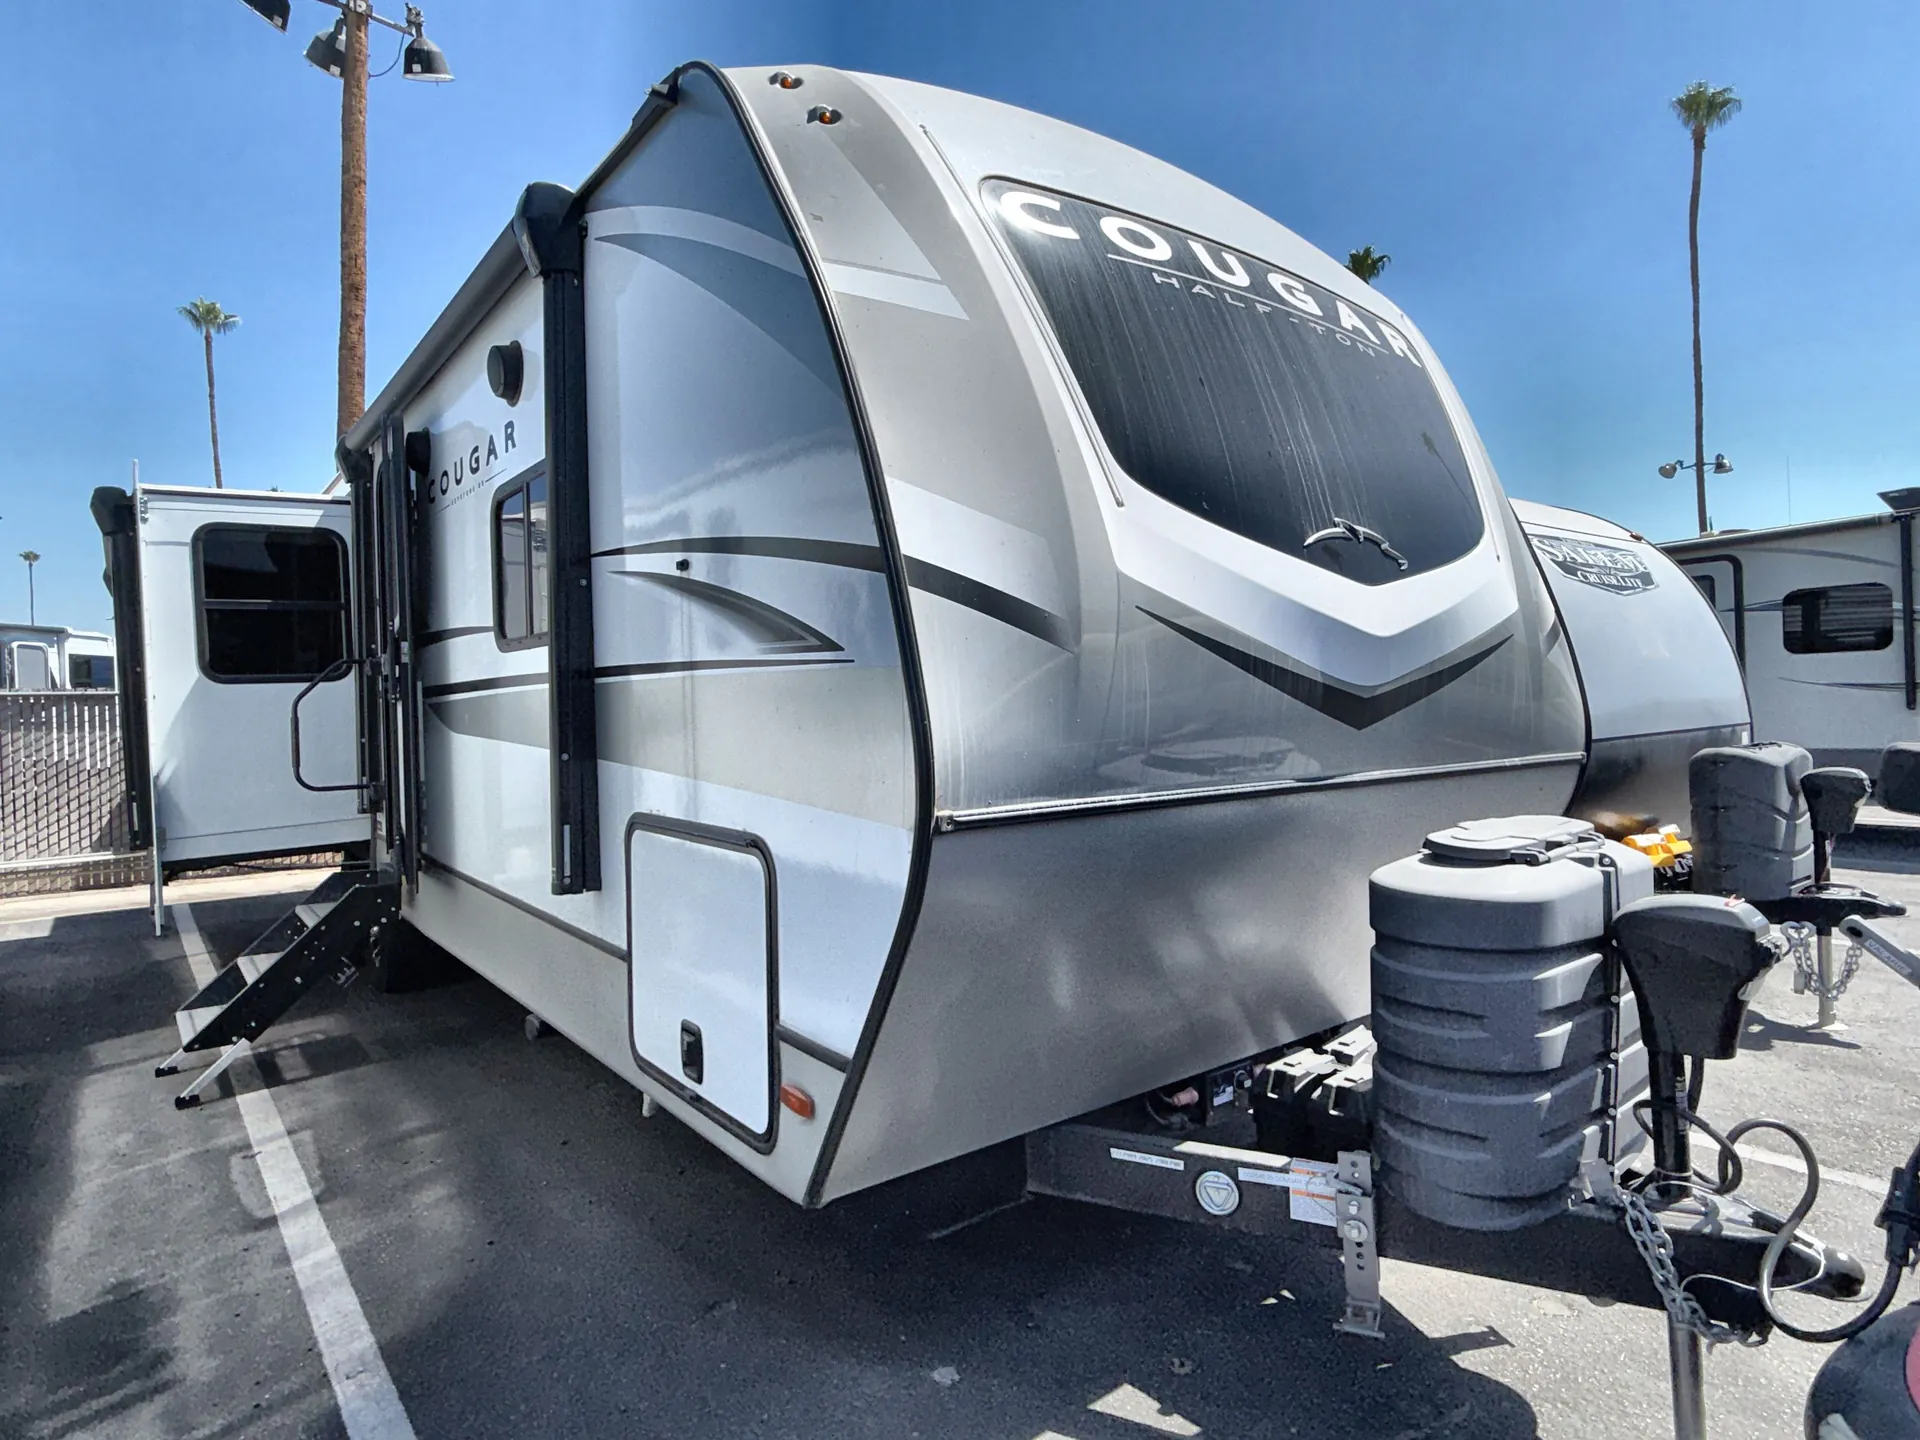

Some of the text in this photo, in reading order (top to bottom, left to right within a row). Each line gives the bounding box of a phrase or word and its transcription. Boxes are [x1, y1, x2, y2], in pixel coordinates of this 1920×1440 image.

[1000, 191, 1422, 368] COUGAR
[428, 420, 517, 504] COUGAR
[1532, 538, 1650, 573] SALEM
